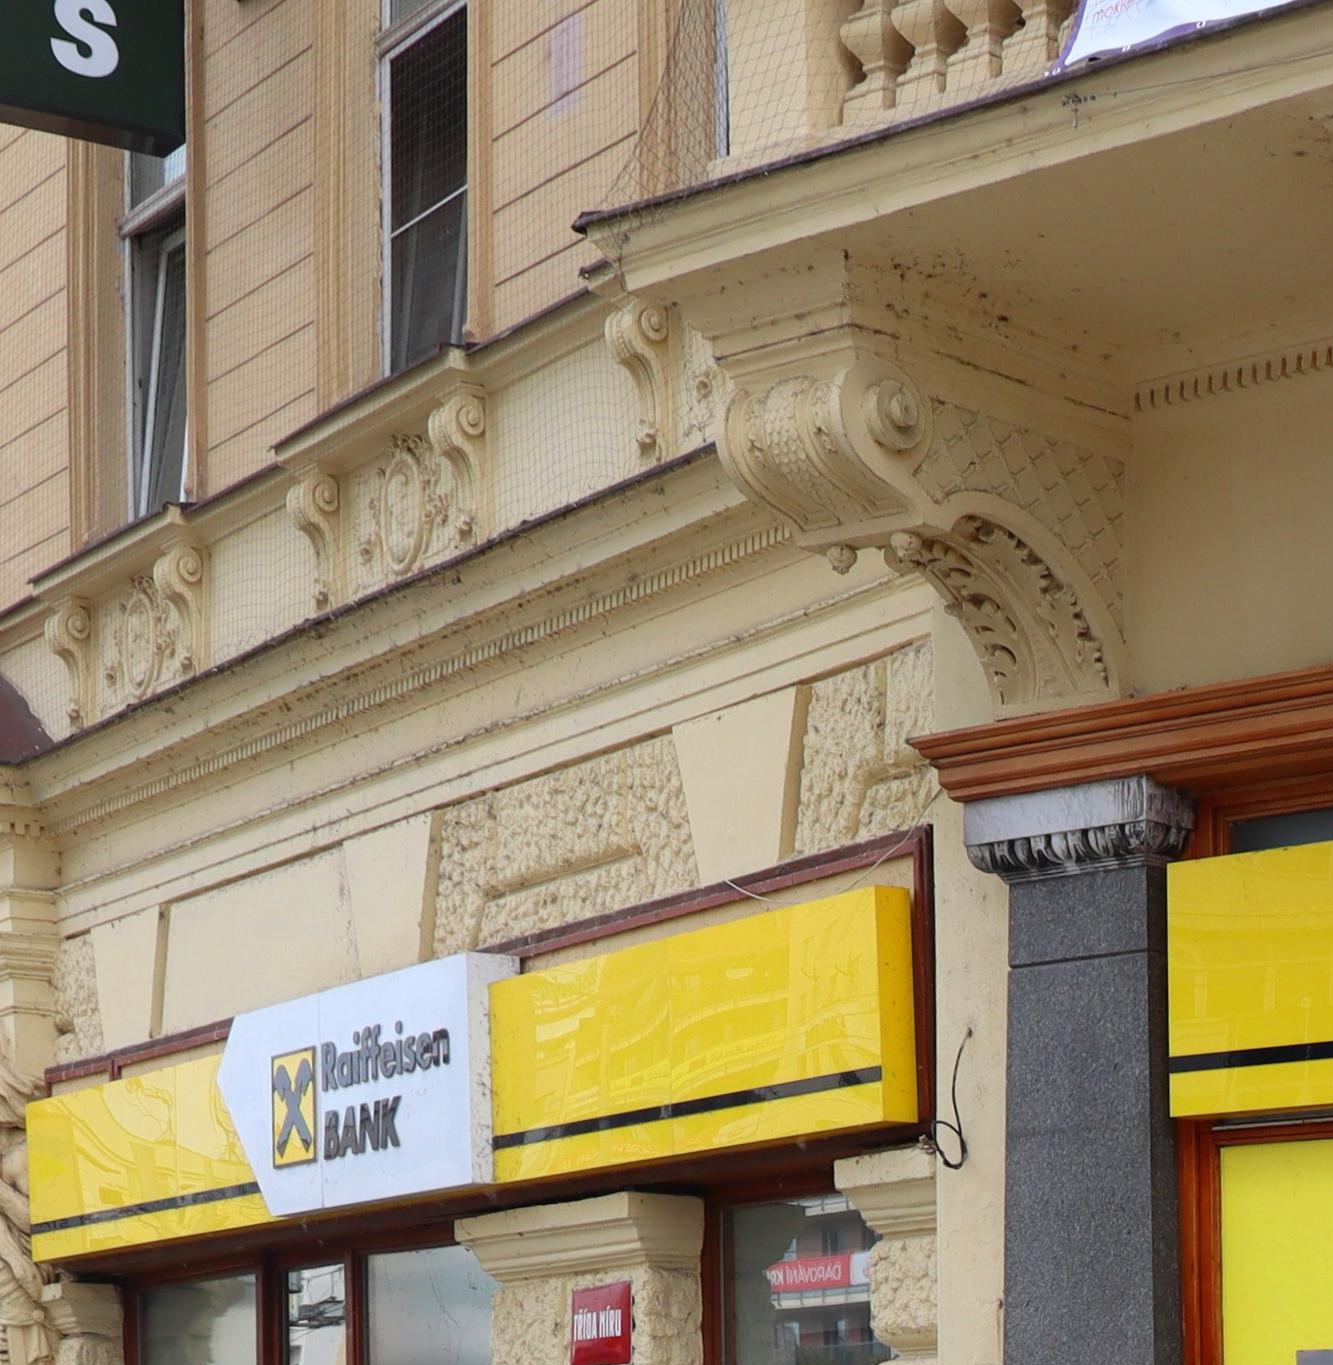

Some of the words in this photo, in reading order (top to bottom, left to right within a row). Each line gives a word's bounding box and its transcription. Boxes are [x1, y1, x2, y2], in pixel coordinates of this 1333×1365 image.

[50, 0, 119, 78] S
[320, 1019, 451, 1093] Raiffeisen
[323, 1095, 402, 1161] BANK
[573, 1307, 598, 1342] TŘÍDA
[598, 1304, 622, 1339] MÍRU
